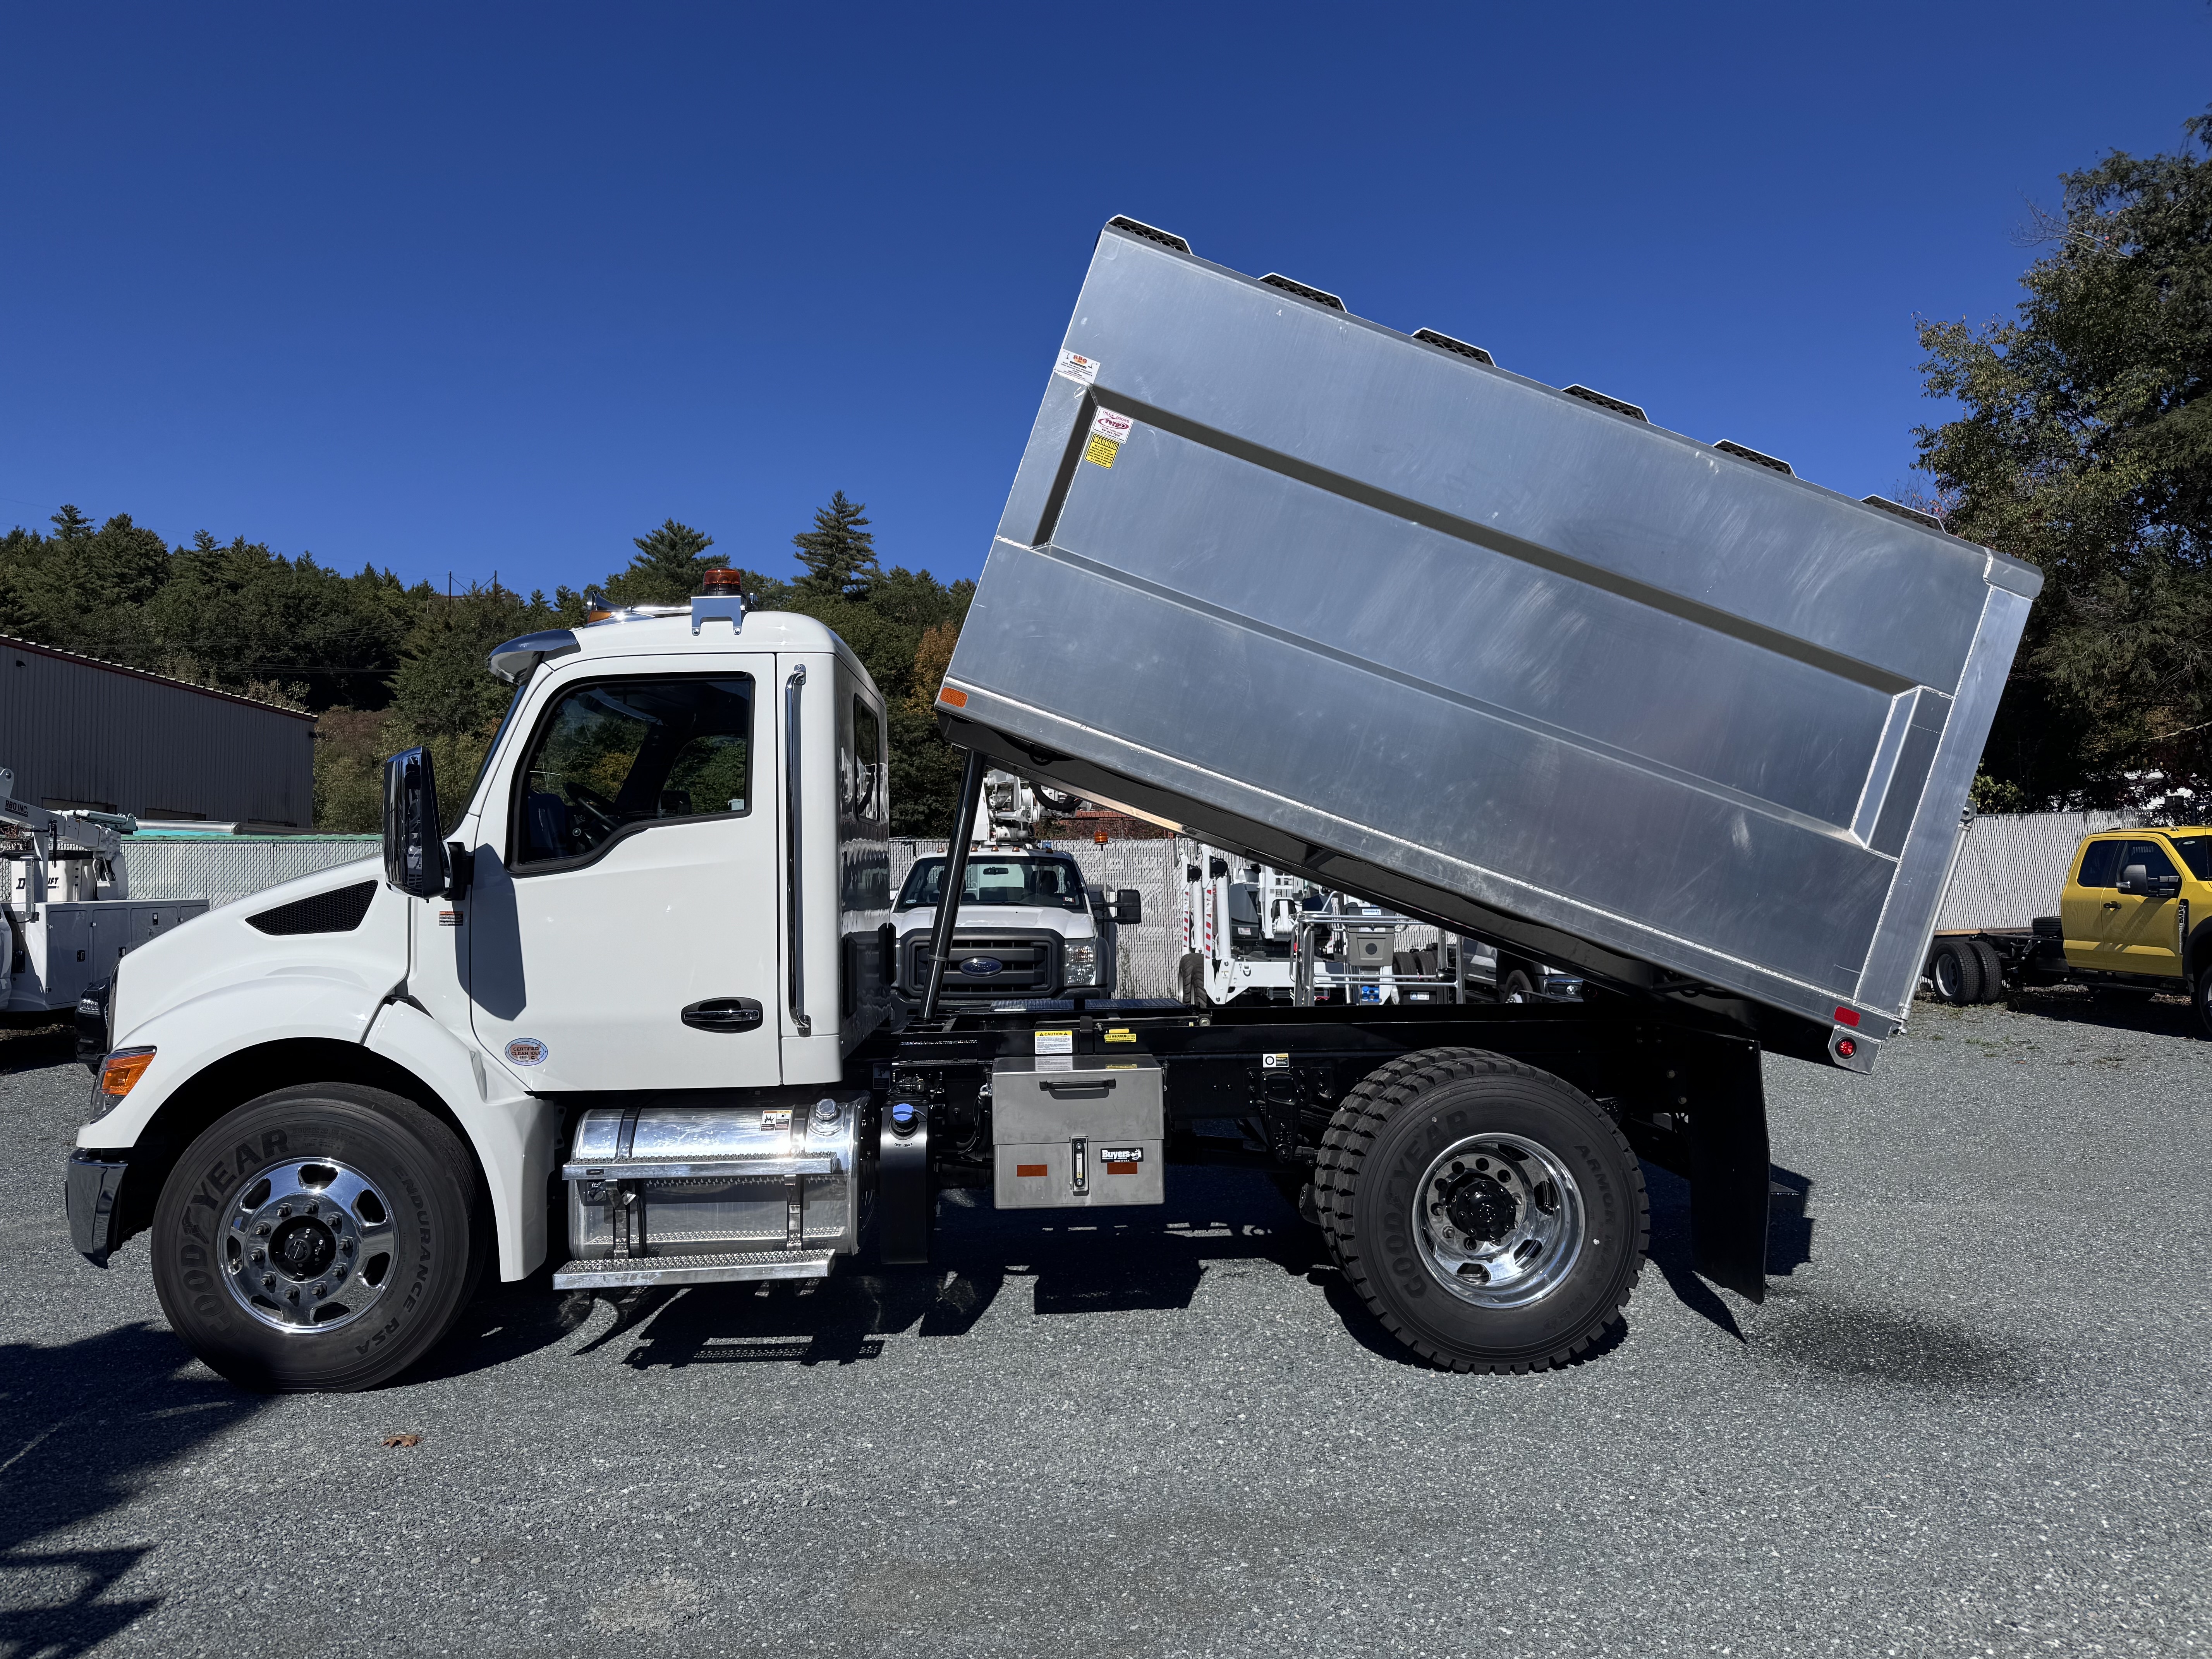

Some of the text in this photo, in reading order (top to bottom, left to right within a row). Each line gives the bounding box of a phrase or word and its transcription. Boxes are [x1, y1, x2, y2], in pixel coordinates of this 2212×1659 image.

[1094, 436, 1117, 450] WARNING
[5, 800, 17, 810] RBG
[17, 804, 28, 814] INC.
[1102, 1149, 1130, 1159] Buyers
[1574, 1145, 1616, 1224] ARMOR
[181, 1129, 289, 1339] GOODYEAR
[1384, 1110, 1469, 1298] GOODYEAR
[355, 1164, 431, 1355] ENDURANCE RSA
[1587, 1235, 1612, 1285] MAX
